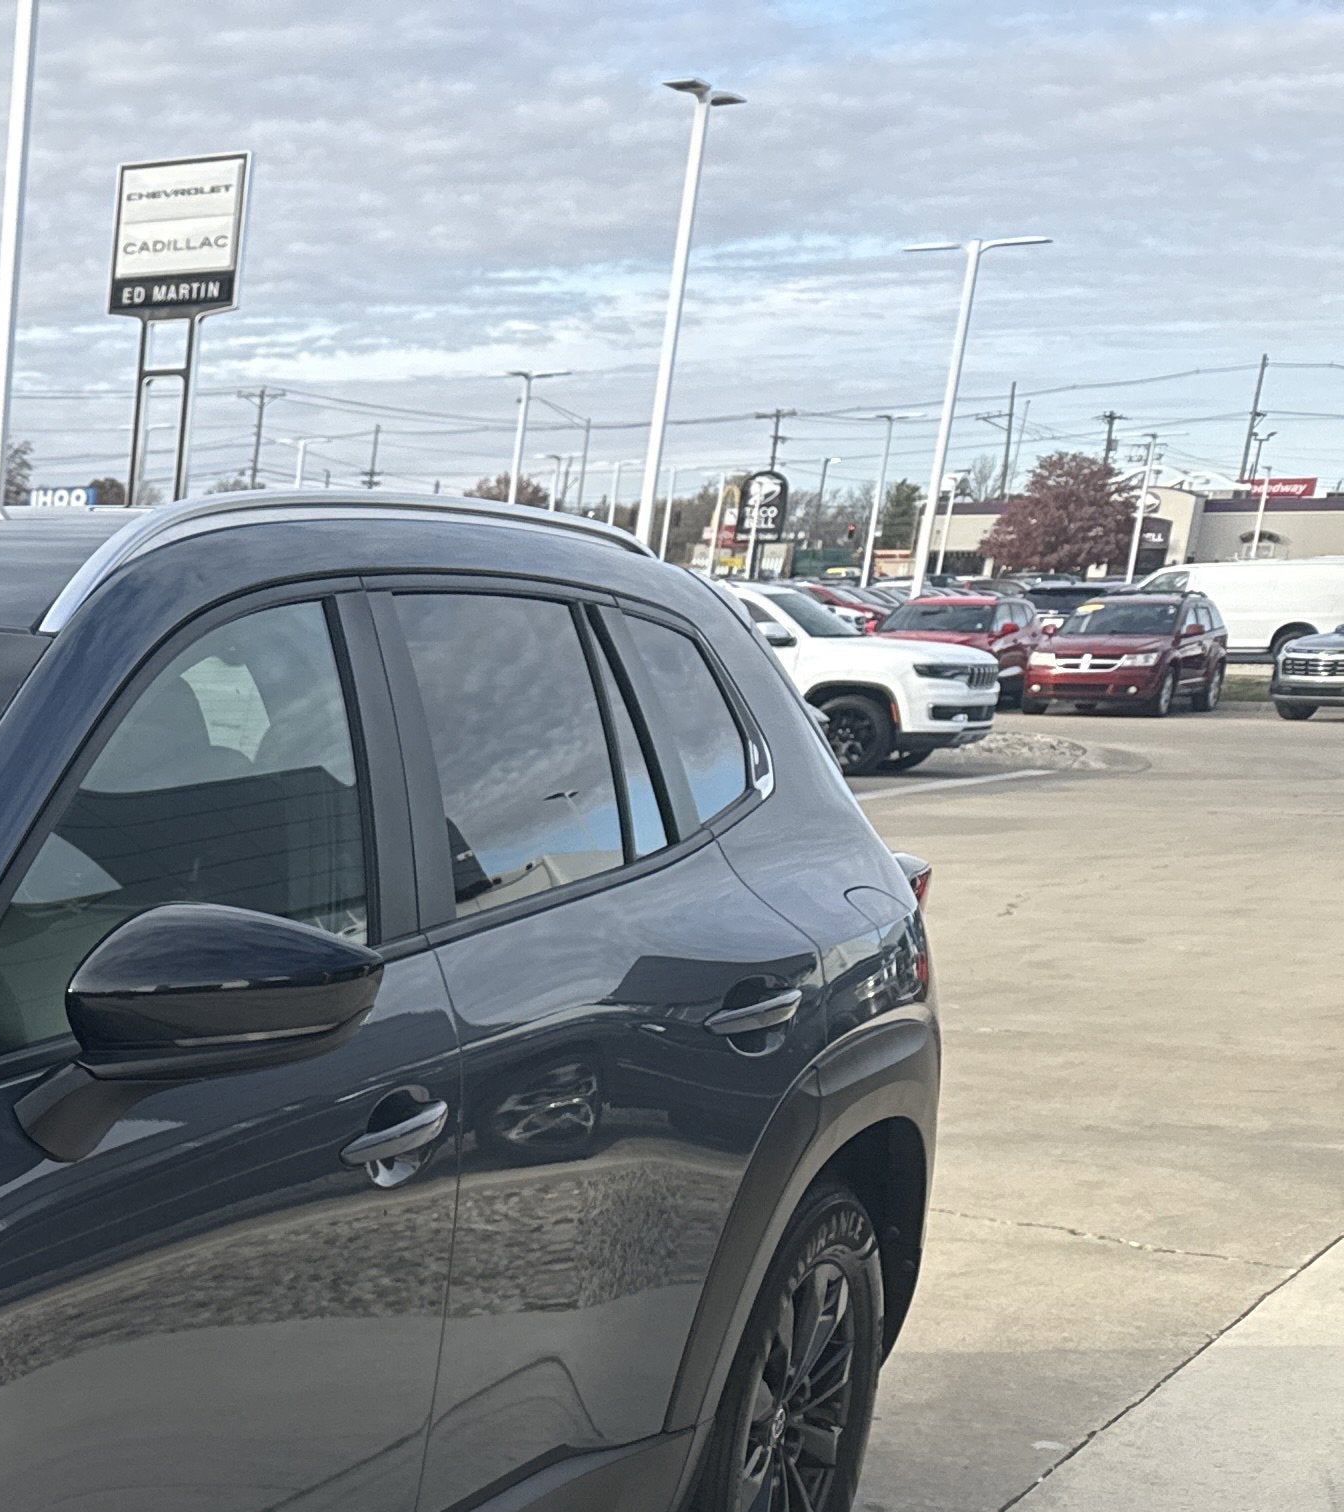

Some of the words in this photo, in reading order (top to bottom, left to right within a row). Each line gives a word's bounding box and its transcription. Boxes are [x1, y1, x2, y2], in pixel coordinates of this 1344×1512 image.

[125, 183, 233, 202] CHEVROLET
[122, 234, 229, 255] CADILLAC
[121, 286, 146, 304] ED
[152, 280, 220, 303] MARTIN
